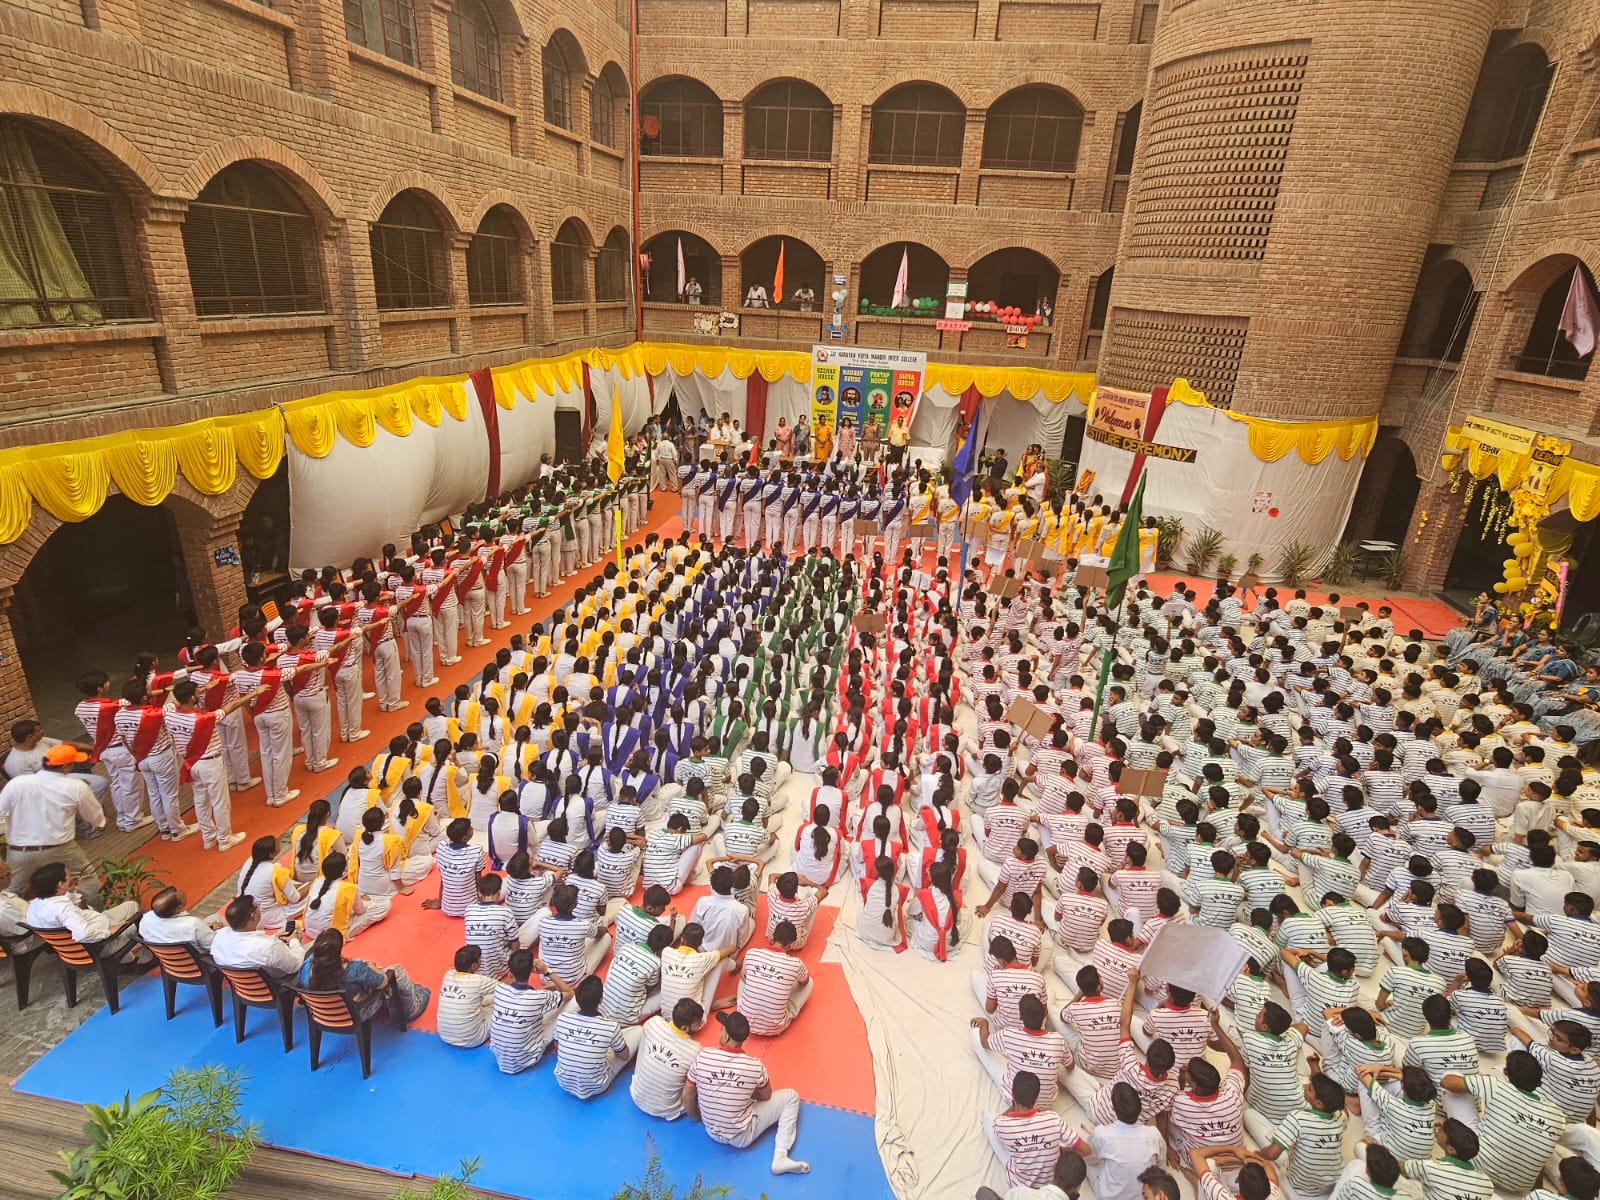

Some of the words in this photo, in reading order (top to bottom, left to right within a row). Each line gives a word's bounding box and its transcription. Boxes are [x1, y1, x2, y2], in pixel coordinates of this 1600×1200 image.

[1122, 441, 1192, 462] CEREMONY
[752, 965, 785, 981] JNVMIC
[1003, 984, 1031, 997] JNVMI
[564, 1028, 600, 1045] JNVMIC
[1170, 1029, 1204, 1042] JNVMIC
[647, 1044, 680, 1068] JNVMIC
[1018, 1050, 1055, 1067] JNVMIC
[1258, 1053, 1292, 1066] JNVMIC
[1442, 1054, 1478, 1068] JNVMIC
[707, 1069, 745, 1087] JNVMIC
[1198, 1121, 1237, 1137] JNVMIC
[1511, 1112, 1556, 1137] JNVMIC
[1011, 1134, 1052, 1152] JNVMIC
